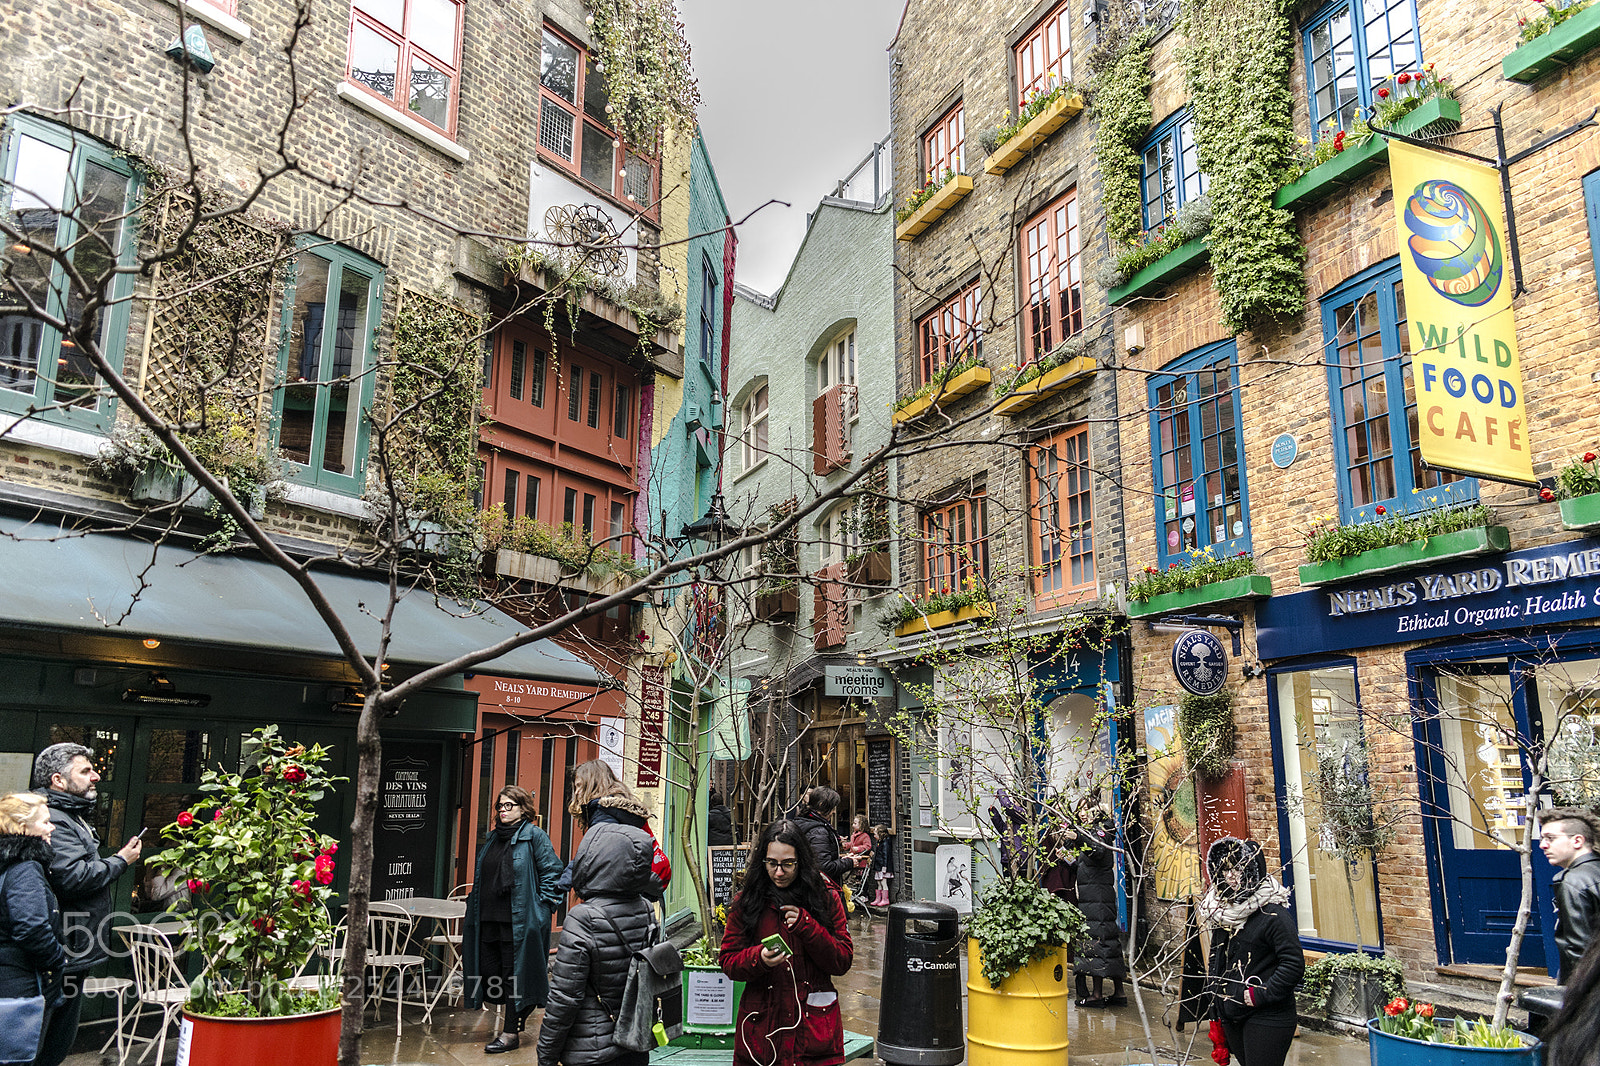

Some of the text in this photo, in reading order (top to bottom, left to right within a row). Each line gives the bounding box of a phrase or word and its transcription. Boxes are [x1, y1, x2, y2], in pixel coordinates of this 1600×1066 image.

[1416, 321, 1512, 368] WILD
[1422, 363, 1517, 409] FOOD
[1427, 405, 1522, 451] CAFÉ
[1327, 582, 1416, 616] NEAL'S
[1416, 569, 1502, 601] YARD
[1397, 610, 1449, 633] Ethical
[1454, 601, 1519, 626] Organic
[1524, 590, 1586, 615] Health
[1180, 635, 1223, 659] NEAL'S YARD
[1065, 653, 1080, 674] 14
[835, 674, 885, 688] meeting
[1182, 669, 1223, 689] REMEDIES
[494, 681, 524, 694] NEAL'S
[526, 684, 549, 696] YARD
[842, 686, 879, 695] rooms
[506, 695, 521, 703] 8-10
[385, 782, 427, 791] DES VINS
[384, 794, 427, 808] SURNATURELS
[388, 862, 412, 876] LUNCH
[923, 962, 957, 970] Camden
